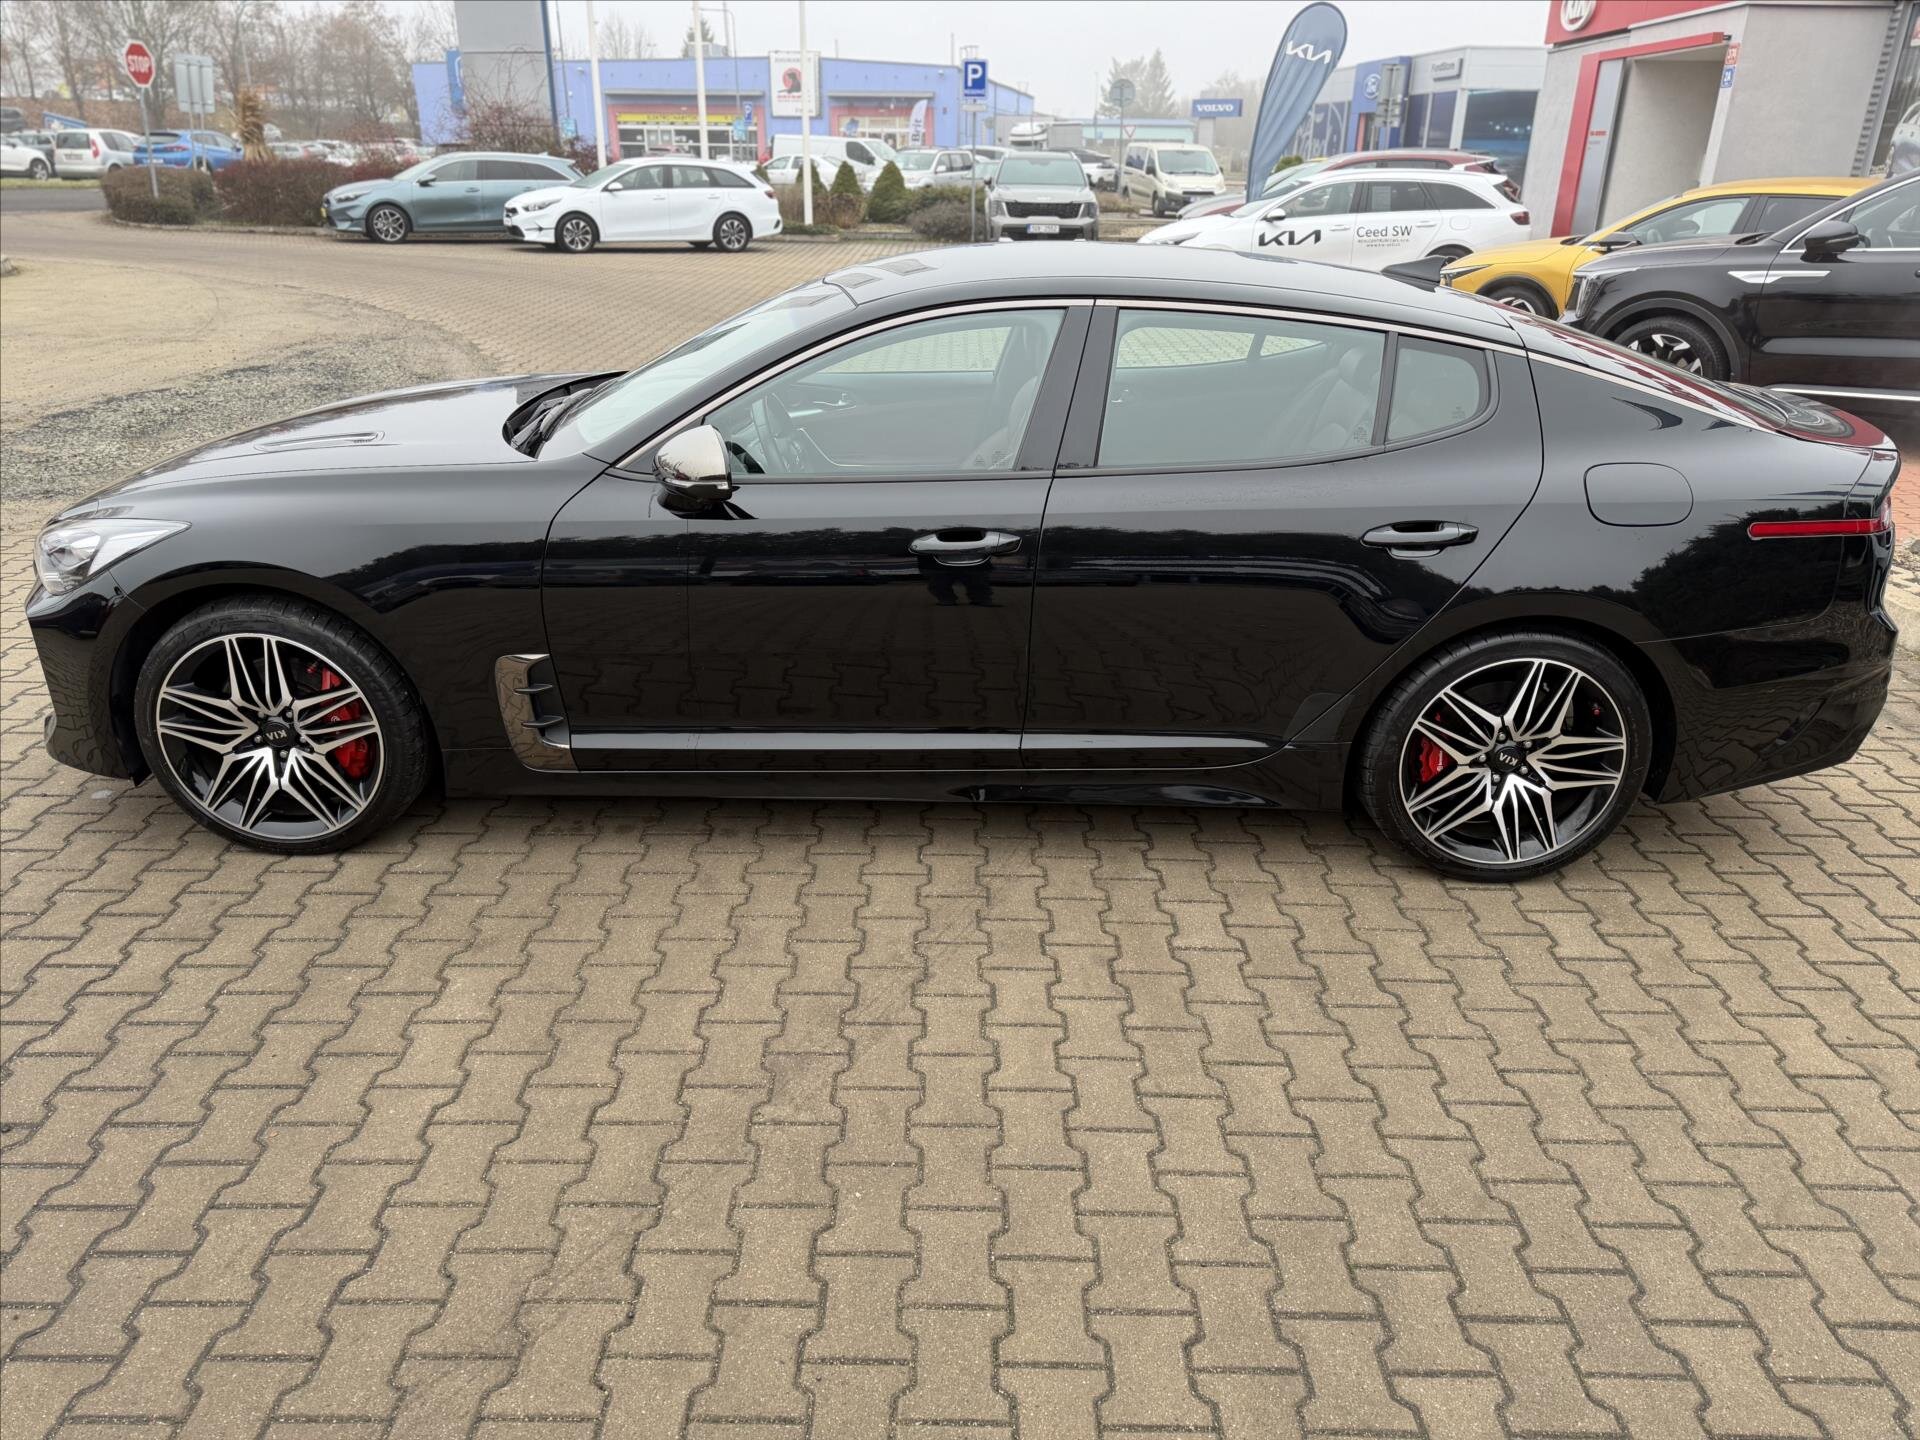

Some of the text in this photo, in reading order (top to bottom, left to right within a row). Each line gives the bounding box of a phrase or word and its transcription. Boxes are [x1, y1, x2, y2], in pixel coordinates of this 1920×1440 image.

[1286, 40, 1332, 64] KIA
[127, 55, 150, 73] STOP
[967, 64, 983, 87] P
[1196, 104, 1234, 112] VOLVO
[1258, 229, 1321, 246] KIA
[1356, 225, 1412, 237] Ceed SW
[266, 730, 287, 740] KIA
[1499, 752, 1518, 767] KIA
